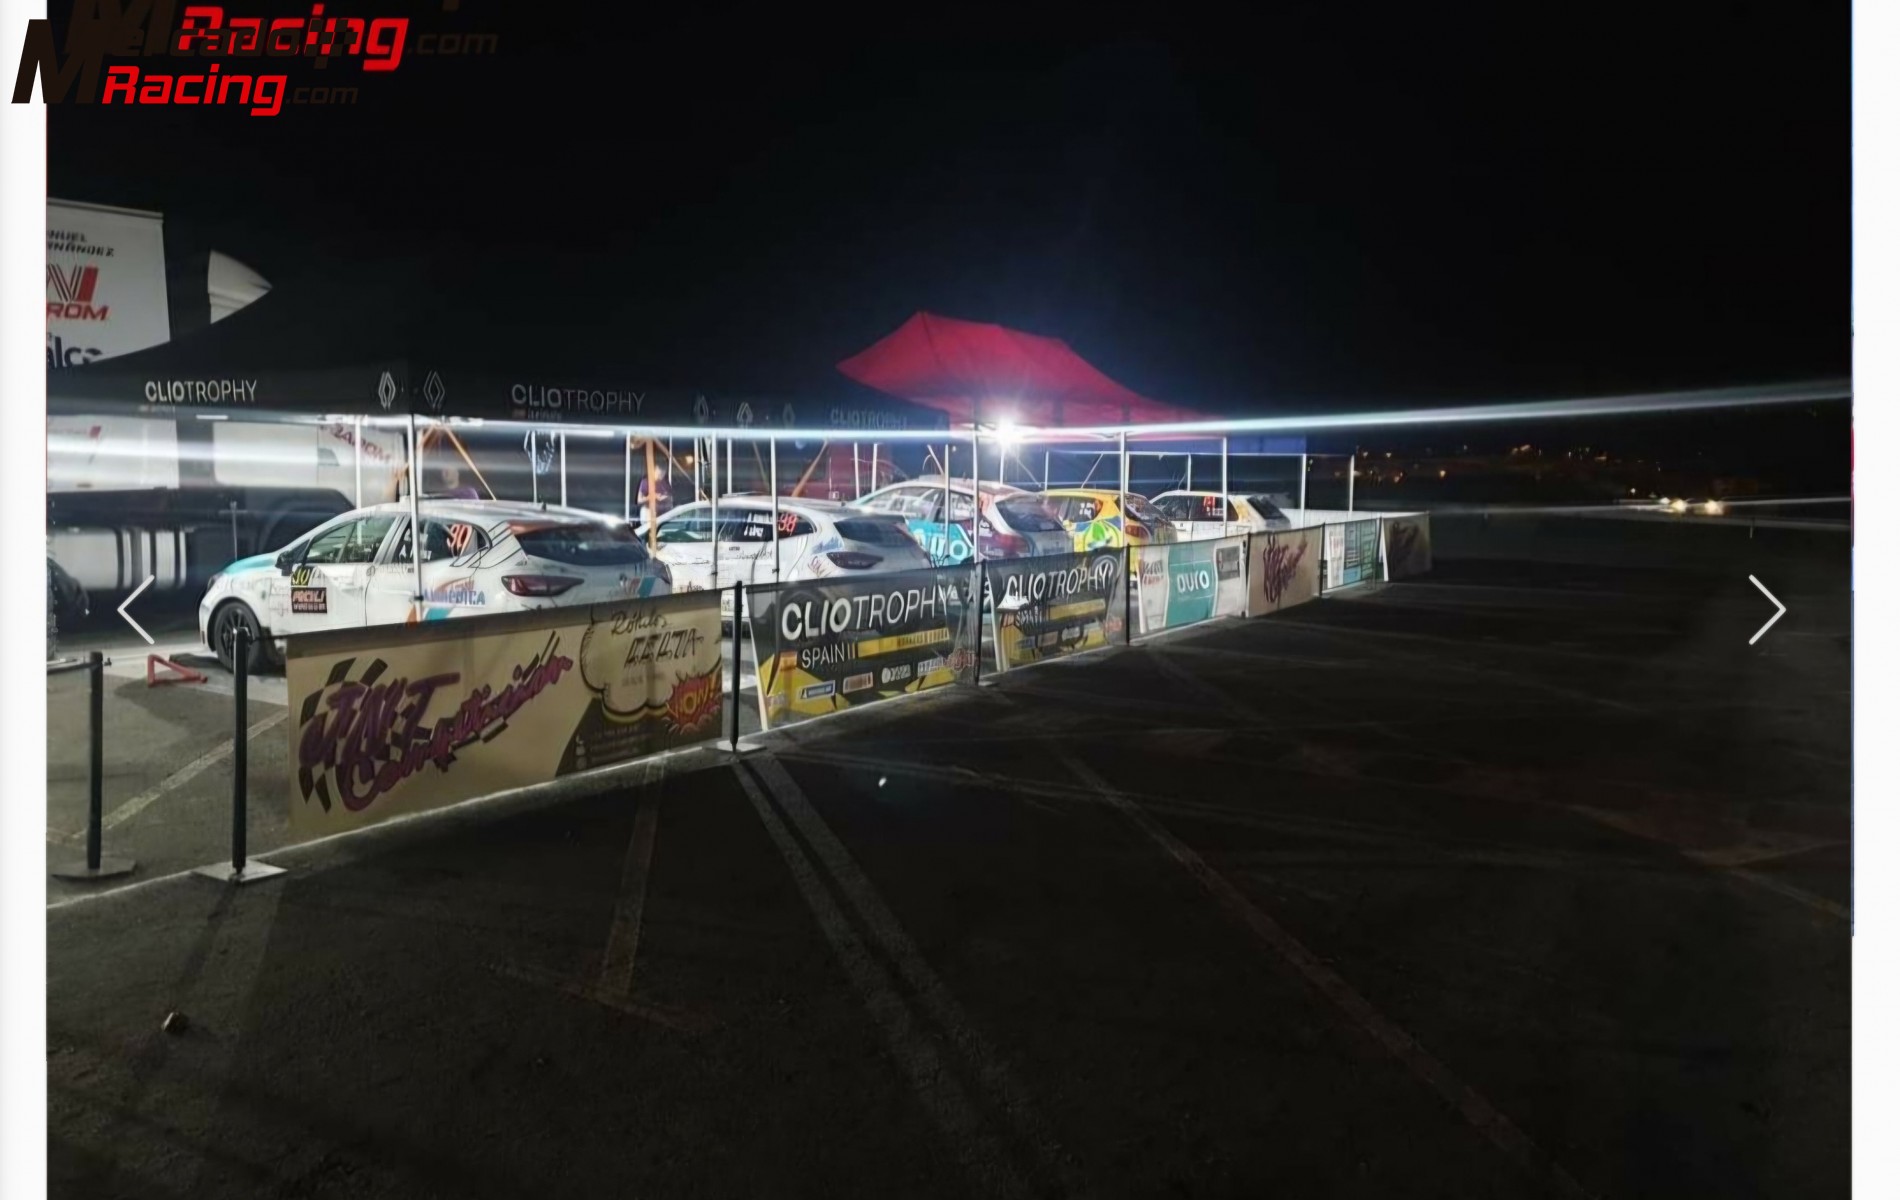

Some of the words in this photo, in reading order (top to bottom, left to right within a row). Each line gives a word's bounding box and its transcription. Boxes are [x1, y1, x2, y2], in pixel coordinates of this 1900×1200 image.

[46, 230, 87, 242] NUEL
[145, 379, 257, 403] CLIOTROPHY
[511, 383, 646, 415] CLIOTROPHY
[1005, 563, 1113, 602] CLIOTROPHY
[1177, 570, 1210, 594] auro
[781, 584, 951, 640] CLIOTROPHY
[802, 644, 845, 669] SPAIN
